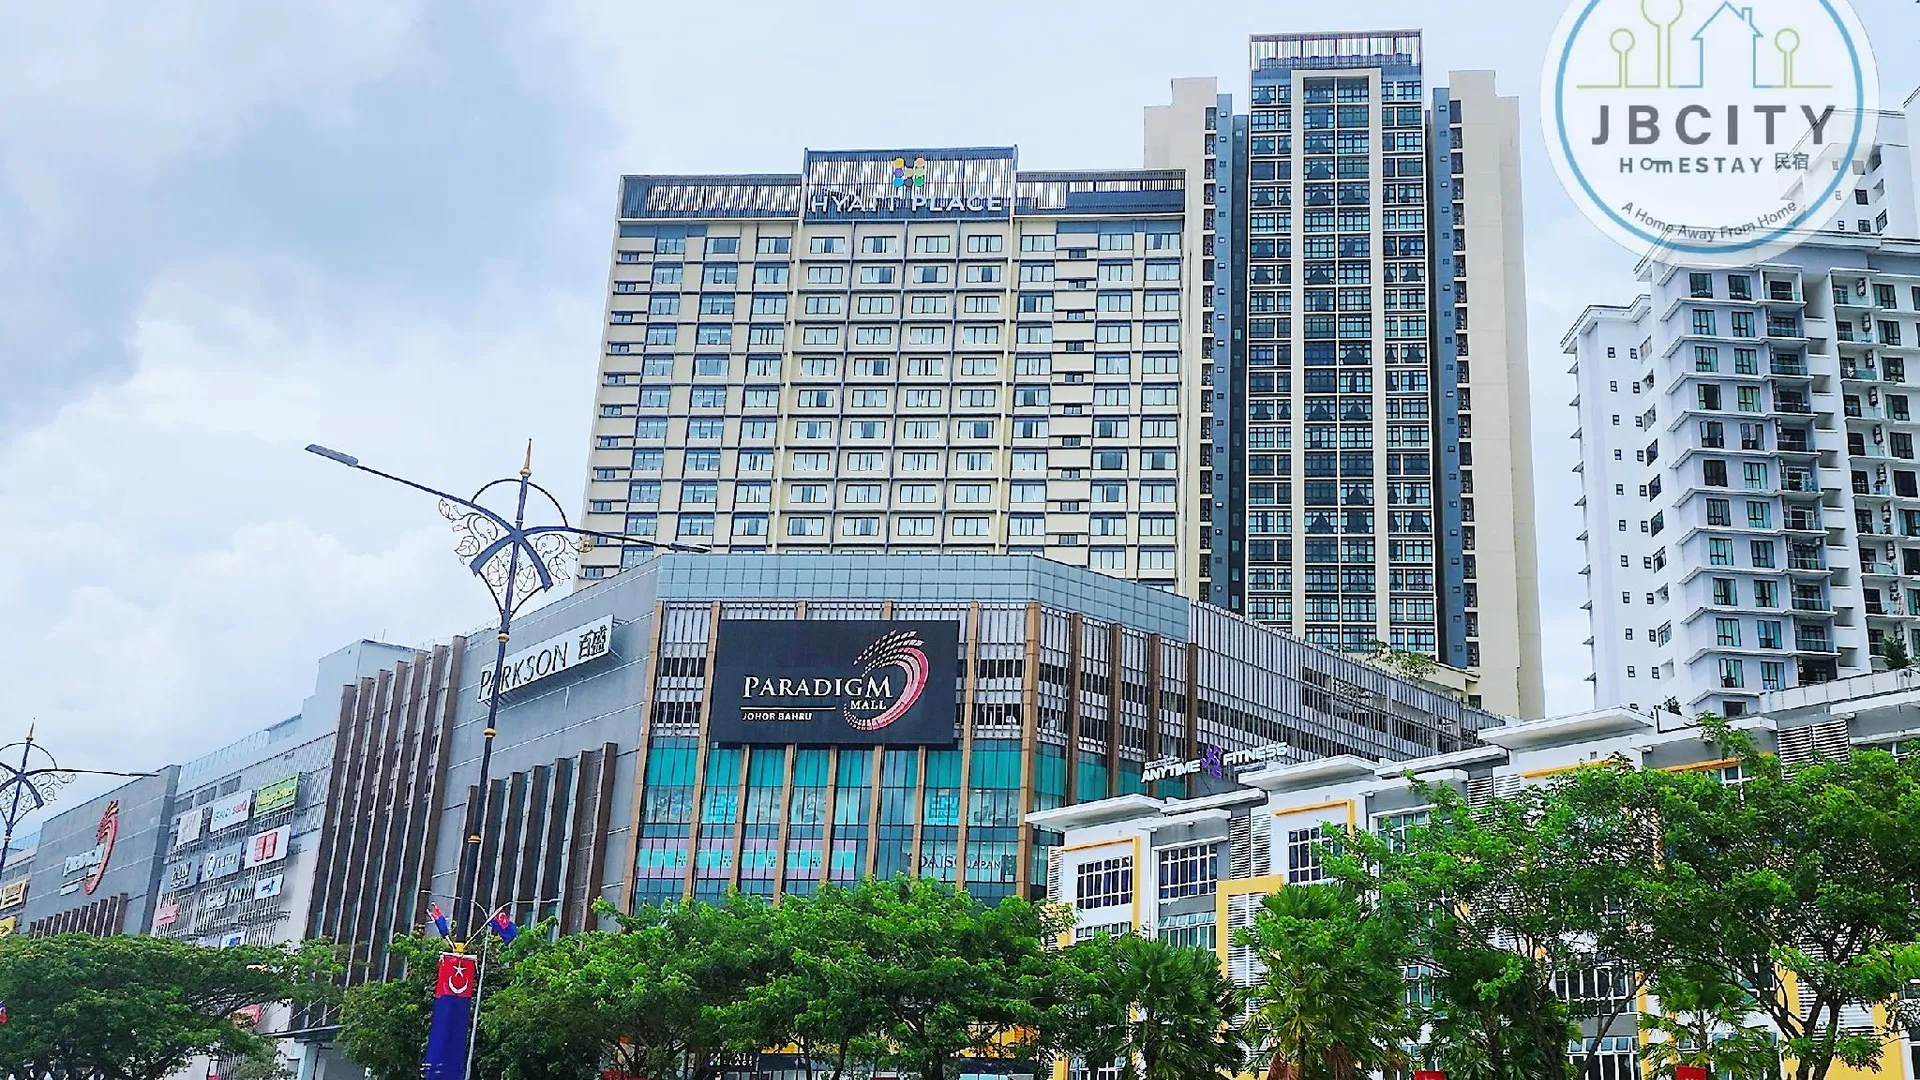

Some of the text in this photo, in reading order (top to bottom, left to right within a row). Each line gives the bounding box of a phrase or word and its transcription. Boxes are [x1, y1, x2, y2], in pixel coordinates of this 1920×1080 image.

[811, 194, 1003, 213] HYATT PLACE
[578, 624, 608, 660] 百盛
[742, 675, 893, 699] PARADIGM
[850, 700, 887, 711] MALL
[742, 711, 813, 721] JOHOR BAHRU
[1140, 759, 1201, 783] ANYTIME
[1223, 740, 1288, 767] FITNESS
[921, 854, 1001, 870] DAIS JAPAN
